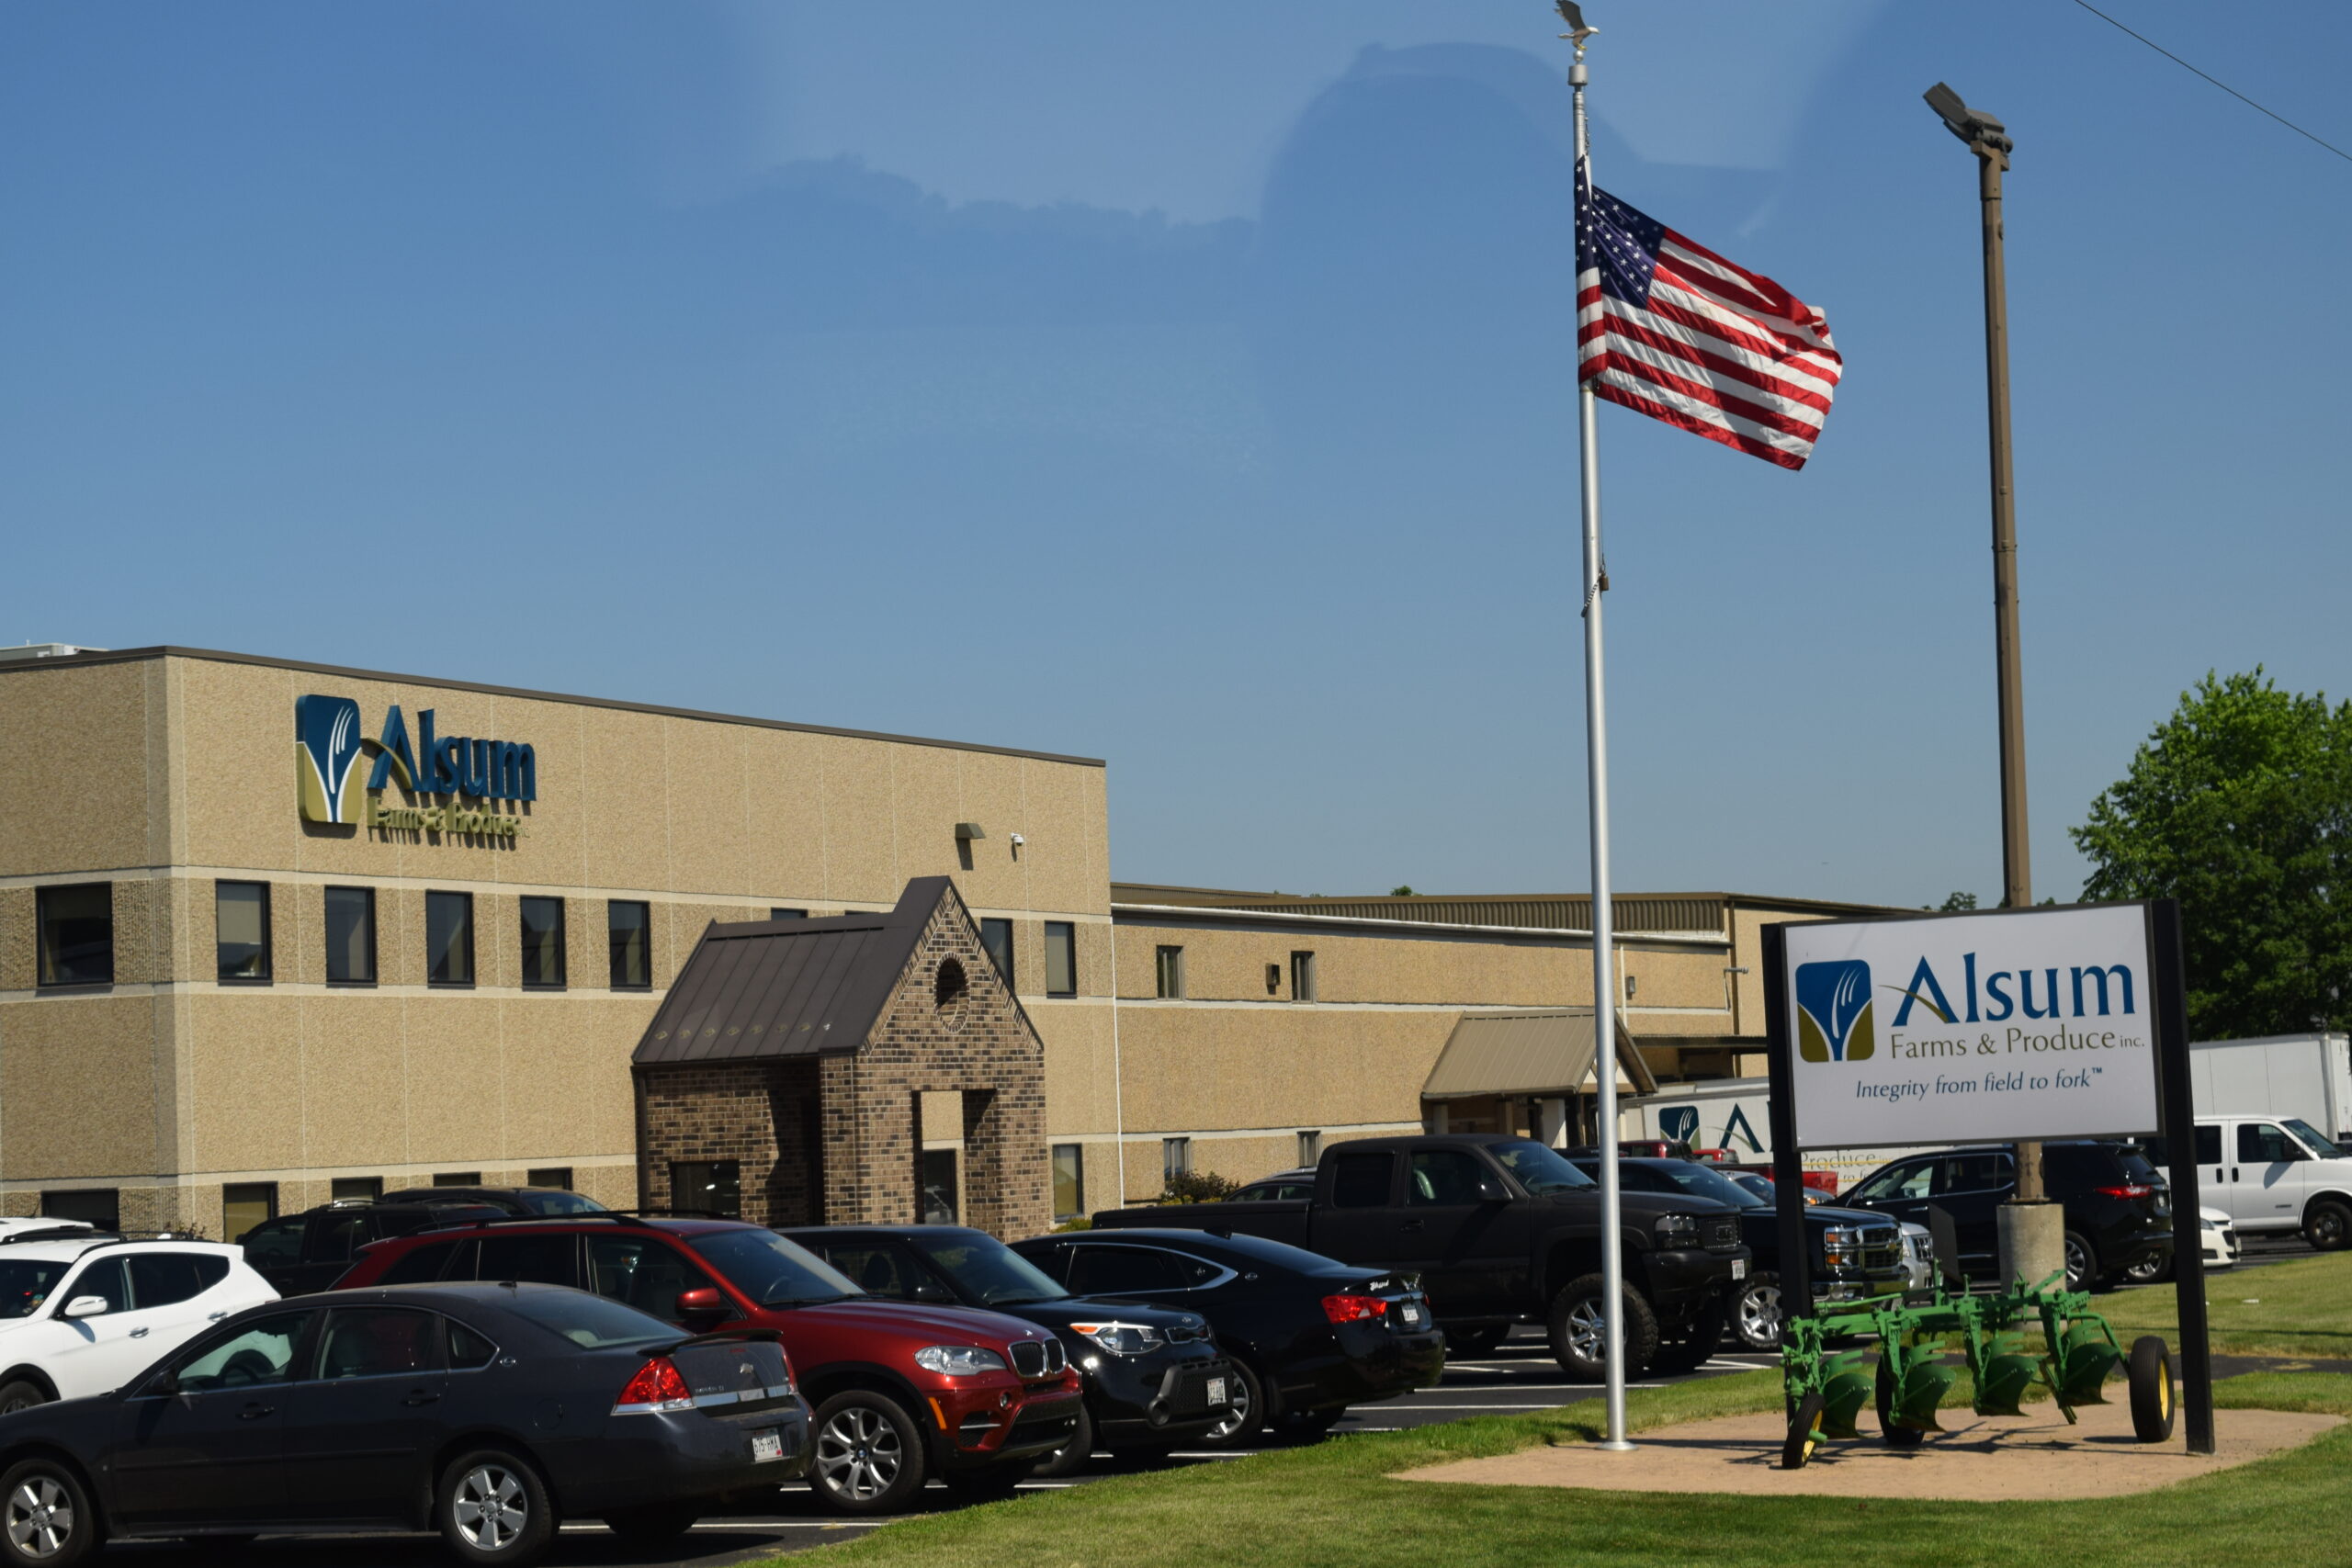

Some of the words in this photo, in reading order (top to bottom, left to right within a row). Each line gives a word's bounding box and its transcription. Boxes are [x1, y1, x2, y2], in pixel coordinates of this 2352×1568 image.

[361, 705, 537, 800] Alsum
[368, 796, 425, 829] Farms
[445, 802, 521, 837] Produce
[1879, 952, 2135, 1026] Alsum
[1891, 1033, 1967, 1059] Farms
[1976, 1032, 1997, 1055] &
[2007, 1023, 2116, 1054] Produce
[2120, 1035, 2145, 1048] inc.
[1856, 1080, 1929, 1102] Integrity
[1936, 1074, 1977, 1094] from
[1984, 1071, 2023, 1092] field
[2030, 1076, 2048, 1090] to
